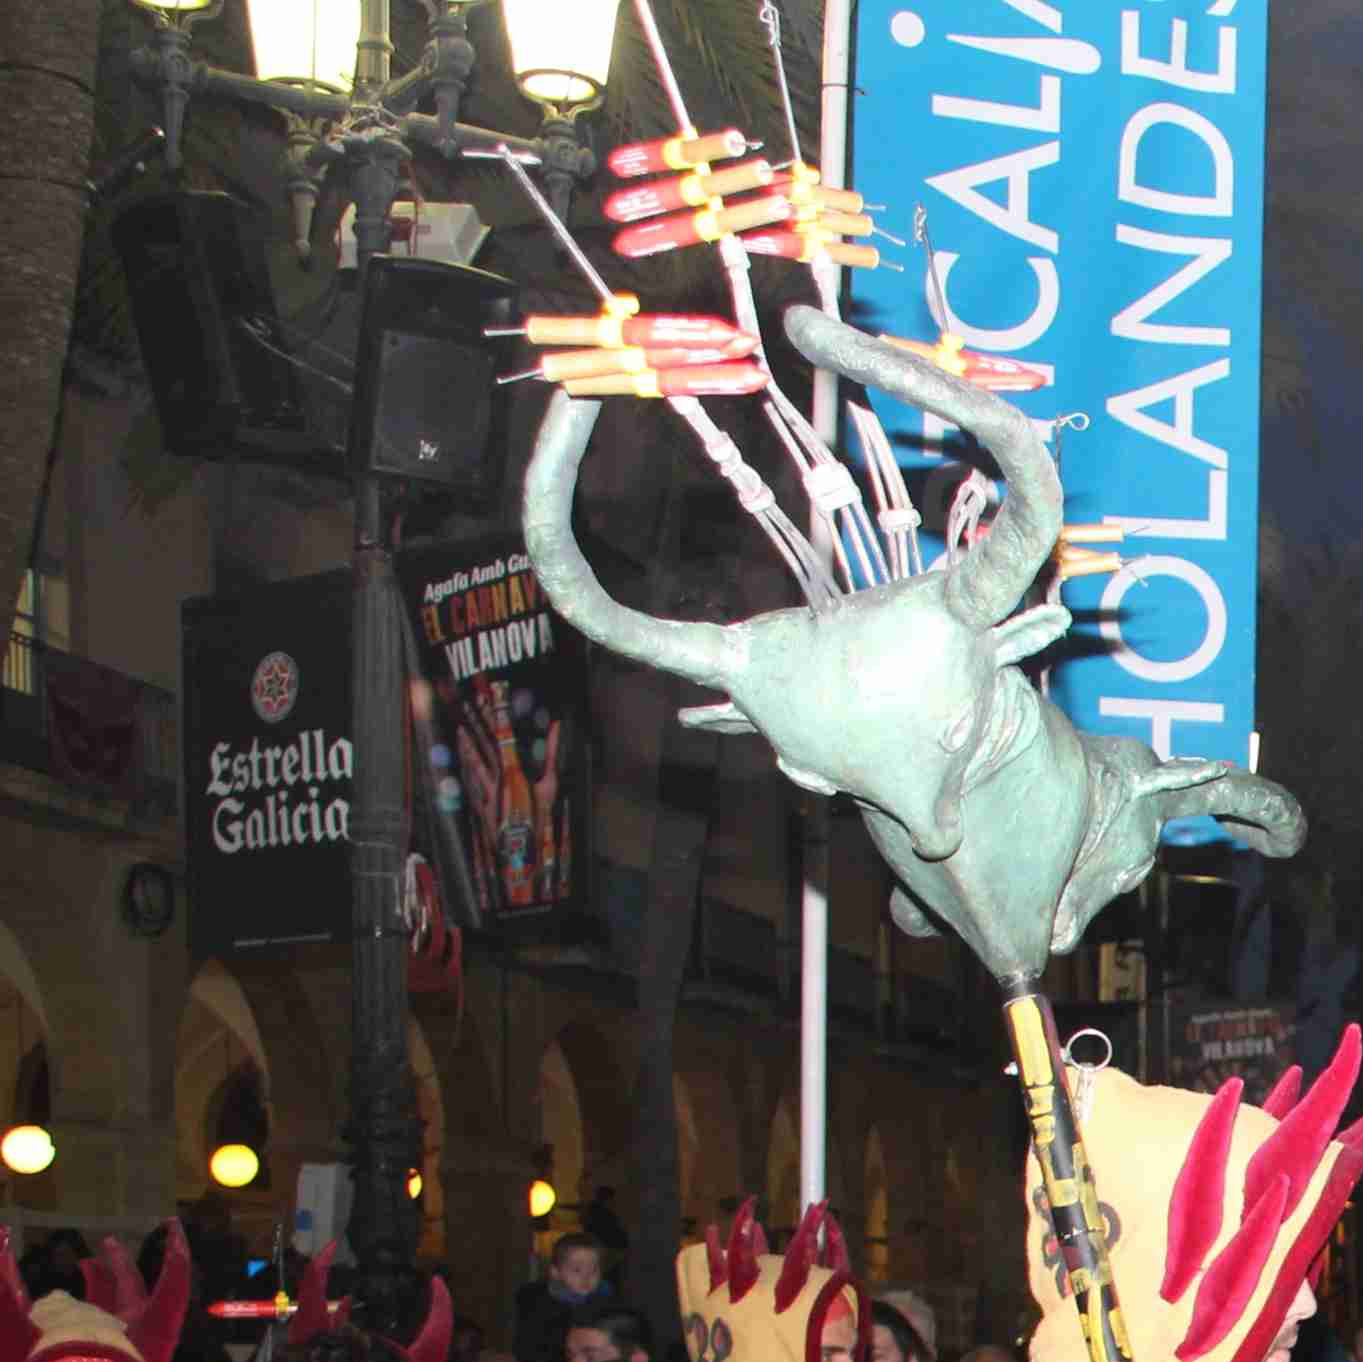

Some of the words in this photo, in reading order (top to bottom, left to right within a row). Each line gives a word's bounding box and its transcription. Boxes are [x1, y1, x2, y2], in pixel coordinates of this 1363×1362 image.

[423, 571, 470, 605] Agafa
[470, 558, 506, 586] Amb
[447, 574, 542, 638] CARNAV
[444, 610, 554, 682] VILANOVA
[206, 728, 352, 797] Estrella
[212, 787, 351, 855] Galicia
